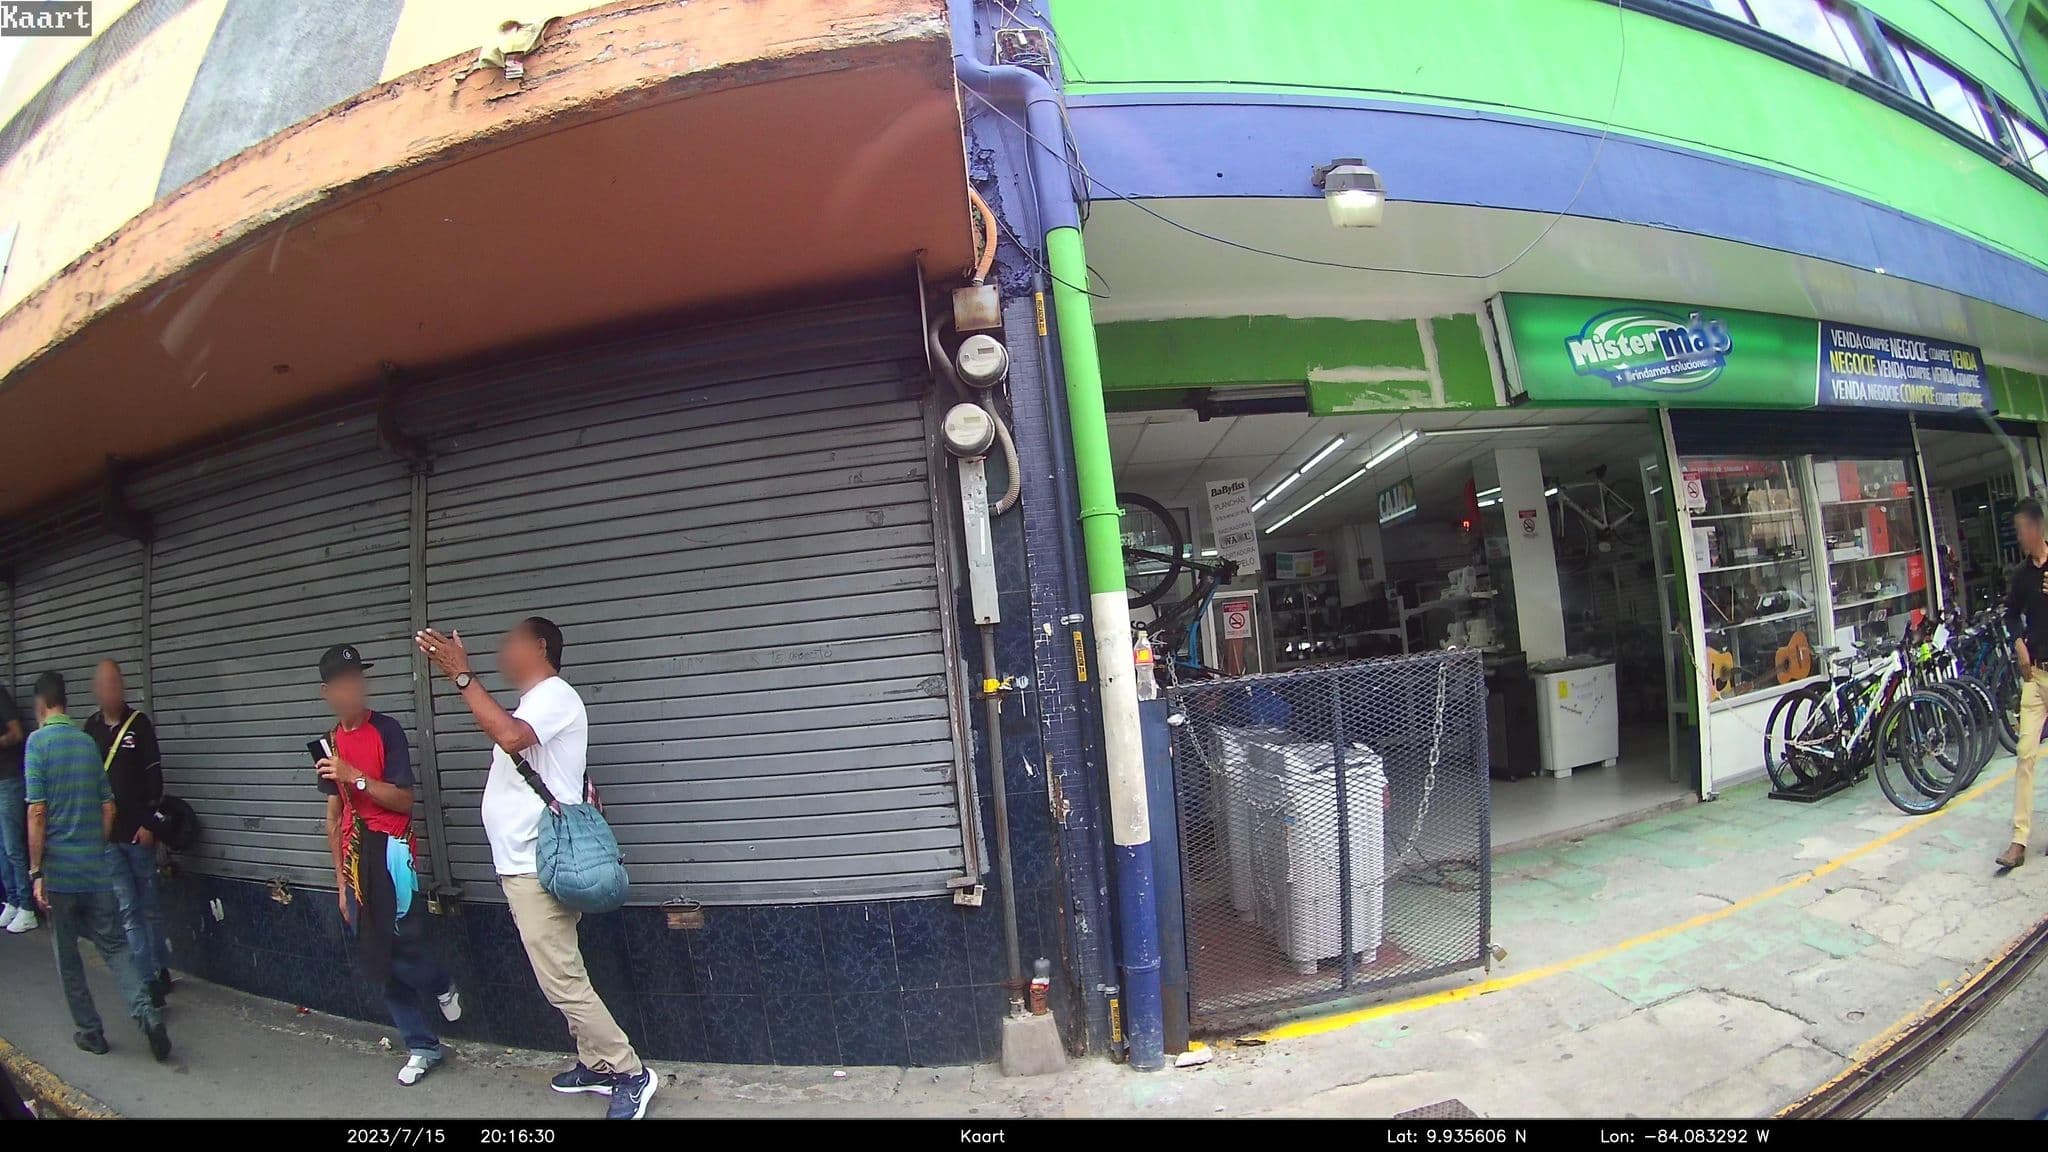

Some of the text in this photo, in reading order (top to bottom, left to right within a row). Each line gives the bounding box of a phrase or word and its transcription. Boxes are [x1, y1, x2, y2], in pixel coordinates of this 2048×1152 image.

[1568, 333, 1656, 366] Mister
[1831, 329, 1978, 371] VENDA COMPRE NEGOCIE COMPRE VENDA
[1830, 351, 1981, 388] NEGOCIE VENDA COMPRE VENDA COMPRE
[1831, 379, 1868, 400] VENDA
[1868, 384, 1899, 402] NEGOCIE
[1901, 384, 1936, 404] COMPRE
[1936, 392, 1959, 407] COMPRE
[1211, 481, 1246, 497] BaByliss
[1214, 496, 1246, 511] PLANCHAS
